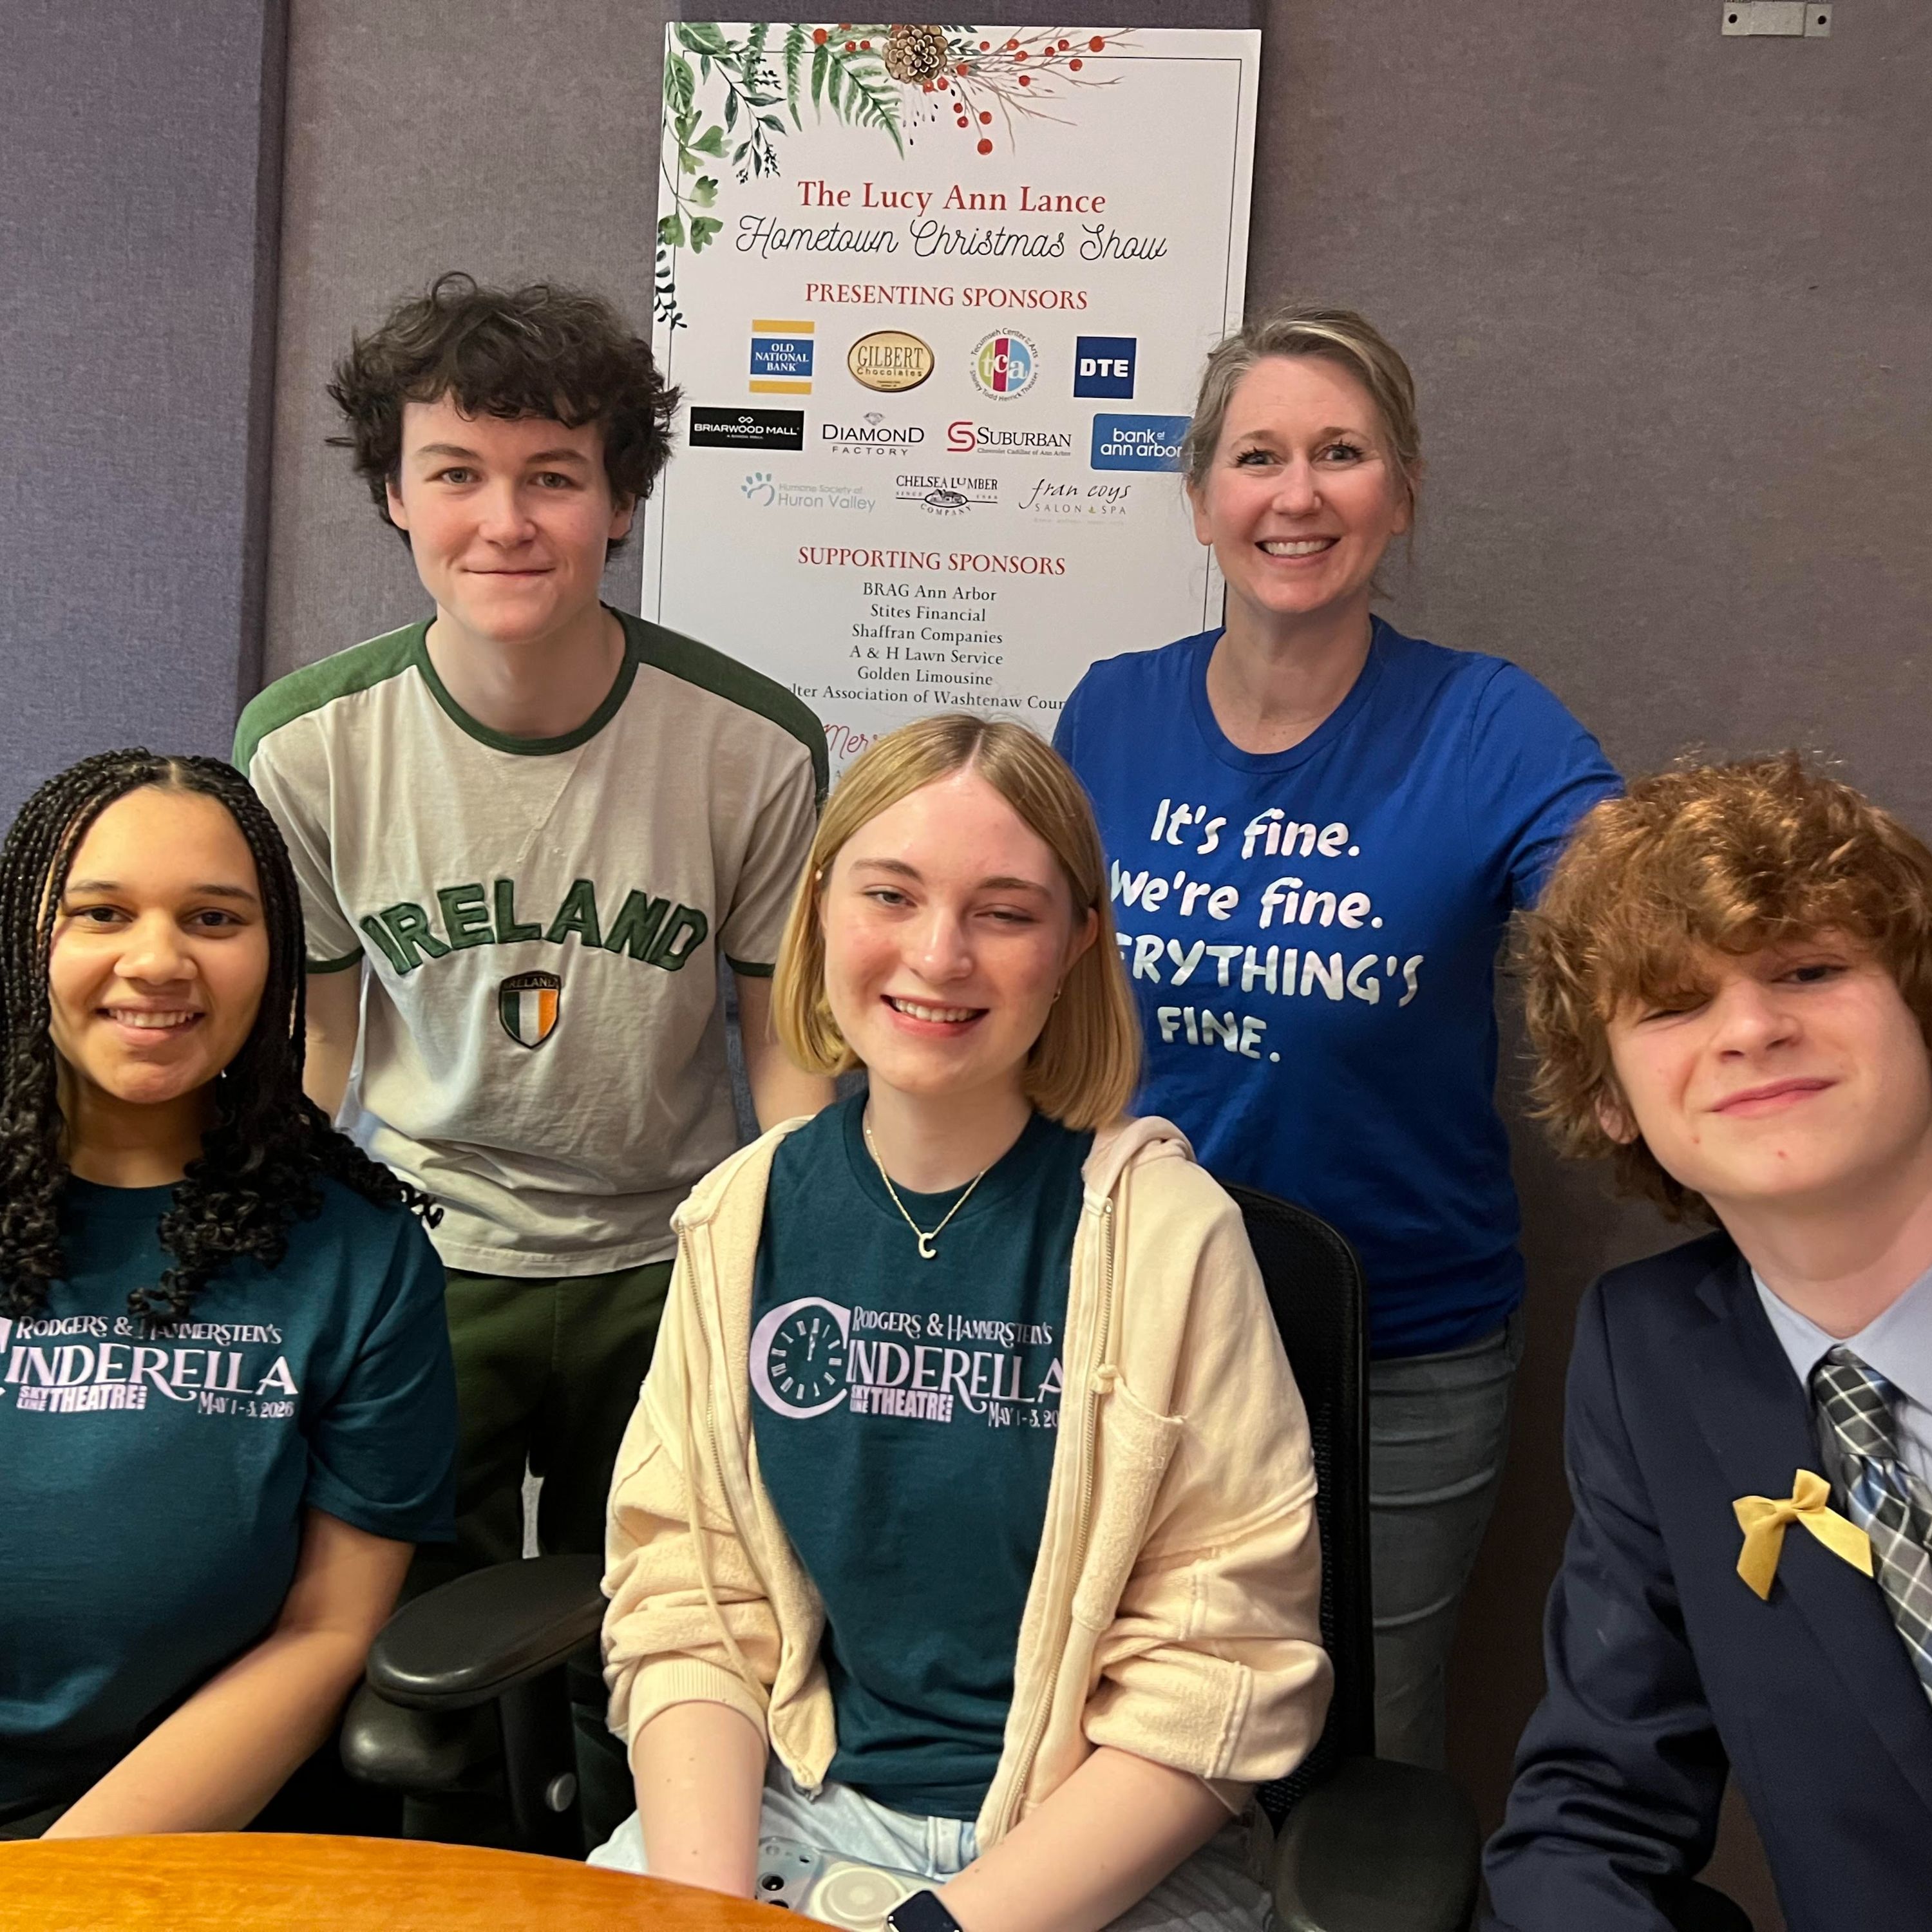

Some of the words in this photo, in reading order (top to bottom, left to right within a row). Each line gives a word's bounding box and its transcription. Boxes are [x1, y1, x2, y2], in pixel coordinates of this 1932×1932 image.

[798, 180, 851, 206] The
[862, 182, 933, 216] Lucy
[943, 185, 1007, 211] Ann
[1019, 186, 1106, 213] Lance
[736, 215, 898, 259] Hometown
[910, 220, 1065, 257] Christmas
[1080, 223, 1168, 260] Show
[805, 283, 954, 306] PRESENTING
[962, 287, 1088, 310] SPONSORS
[772, 343, 794, 352] OLD
[971, 329, 1001, 355] Tecumseh
[755, 352, 809, 362] NATIONAL
[767, 362, 796, 371] BANK
[858, 346, 923, 368] GILBERT
[981, 350, 1028, 379] tca
[857, 367, 922, 377] Chocolates
[1079, 359, 1129, 377] DTE
[694, 424, 764, 434] BRIARWOOD
[766, 426, 797, 435] MALL
[822, 424, 925, 443] DIAMOND
[977, 427, 1072, 447] SUBURBAN
[1113, 428, 1155, 443] bank
[832, 446, 909, 455] FACTORY
[1101, 444, 1133, 456] ann
[1136, 442, 1182, 457] arbor
[896, 475, 947, 488] CHELSEA
[951, 477, 998, 490] LUMBER
[779, 493, 823, 507] Huron
[828, 495, 876, 513] Valley
[1018, 478, 1078, 509] fran
[1087, 485, 1131, 504] coys
[920, 503, 971, 515] COMPANY
[1035, 503, 1081, 513] SALON
[1102, 505, 1126, 515] SPA
[799, 547, 940, 570] SUPPORTING
[948, 553, 1065, 575] SPONSORS
[863, 582, 909, 598] BRAG
[914, 585, 946, 599] Ann
[952, 586, 997, 601] Arbor
[871, 603, 911, 618] Stites
[916, 606, 985, 621] Financial
[852, 623, 915, 639] Shaffran
[921, 627, 1003, 646] Companies
[849, 645, 861, 658] A
[867, 647, 879, 659] &
[886, 647, 899, 659] H
[905, 647, 945, 662] Lawn
[951, 650, 1003, 665] Service
[858, 666, 910, 681] Golden
[916, 669, 993, 685] Limousine
[788, 683, 818, 697] lter
[823, 685, 908, 702] Association
[913, 690, 929, 703] of
[934, 690, 1023, 708] Washtenaw
[1150, 799, 1227, 855] It's
[1242, 808, 1360, 860] fine.
[1259, 876, 1383, 929] fine.
[359, 878, 708, 976] IRELAND
[1115, 933, 1424, 1007] RYTHING'S
[504, 976, 558, 989] RELAND
[1157, 1006, 1281, 1063] FINE.
[16, 1315, 109, 1340] RODGERS
[113, 1316, 133, 1336] &
[852, 1305, 922, 1340] RODGERS
[927, 1312, 944, 1337] &
[0, 1316, 299, 1401] INDERELLA
[750, 1296, 1063, 1419] CINDERELLA
[49, 1384, 138, 1412] THEATRE
[871, 1387, 947, 1421] THEATRE
[1043, 1410, 1059, 1428] 20
